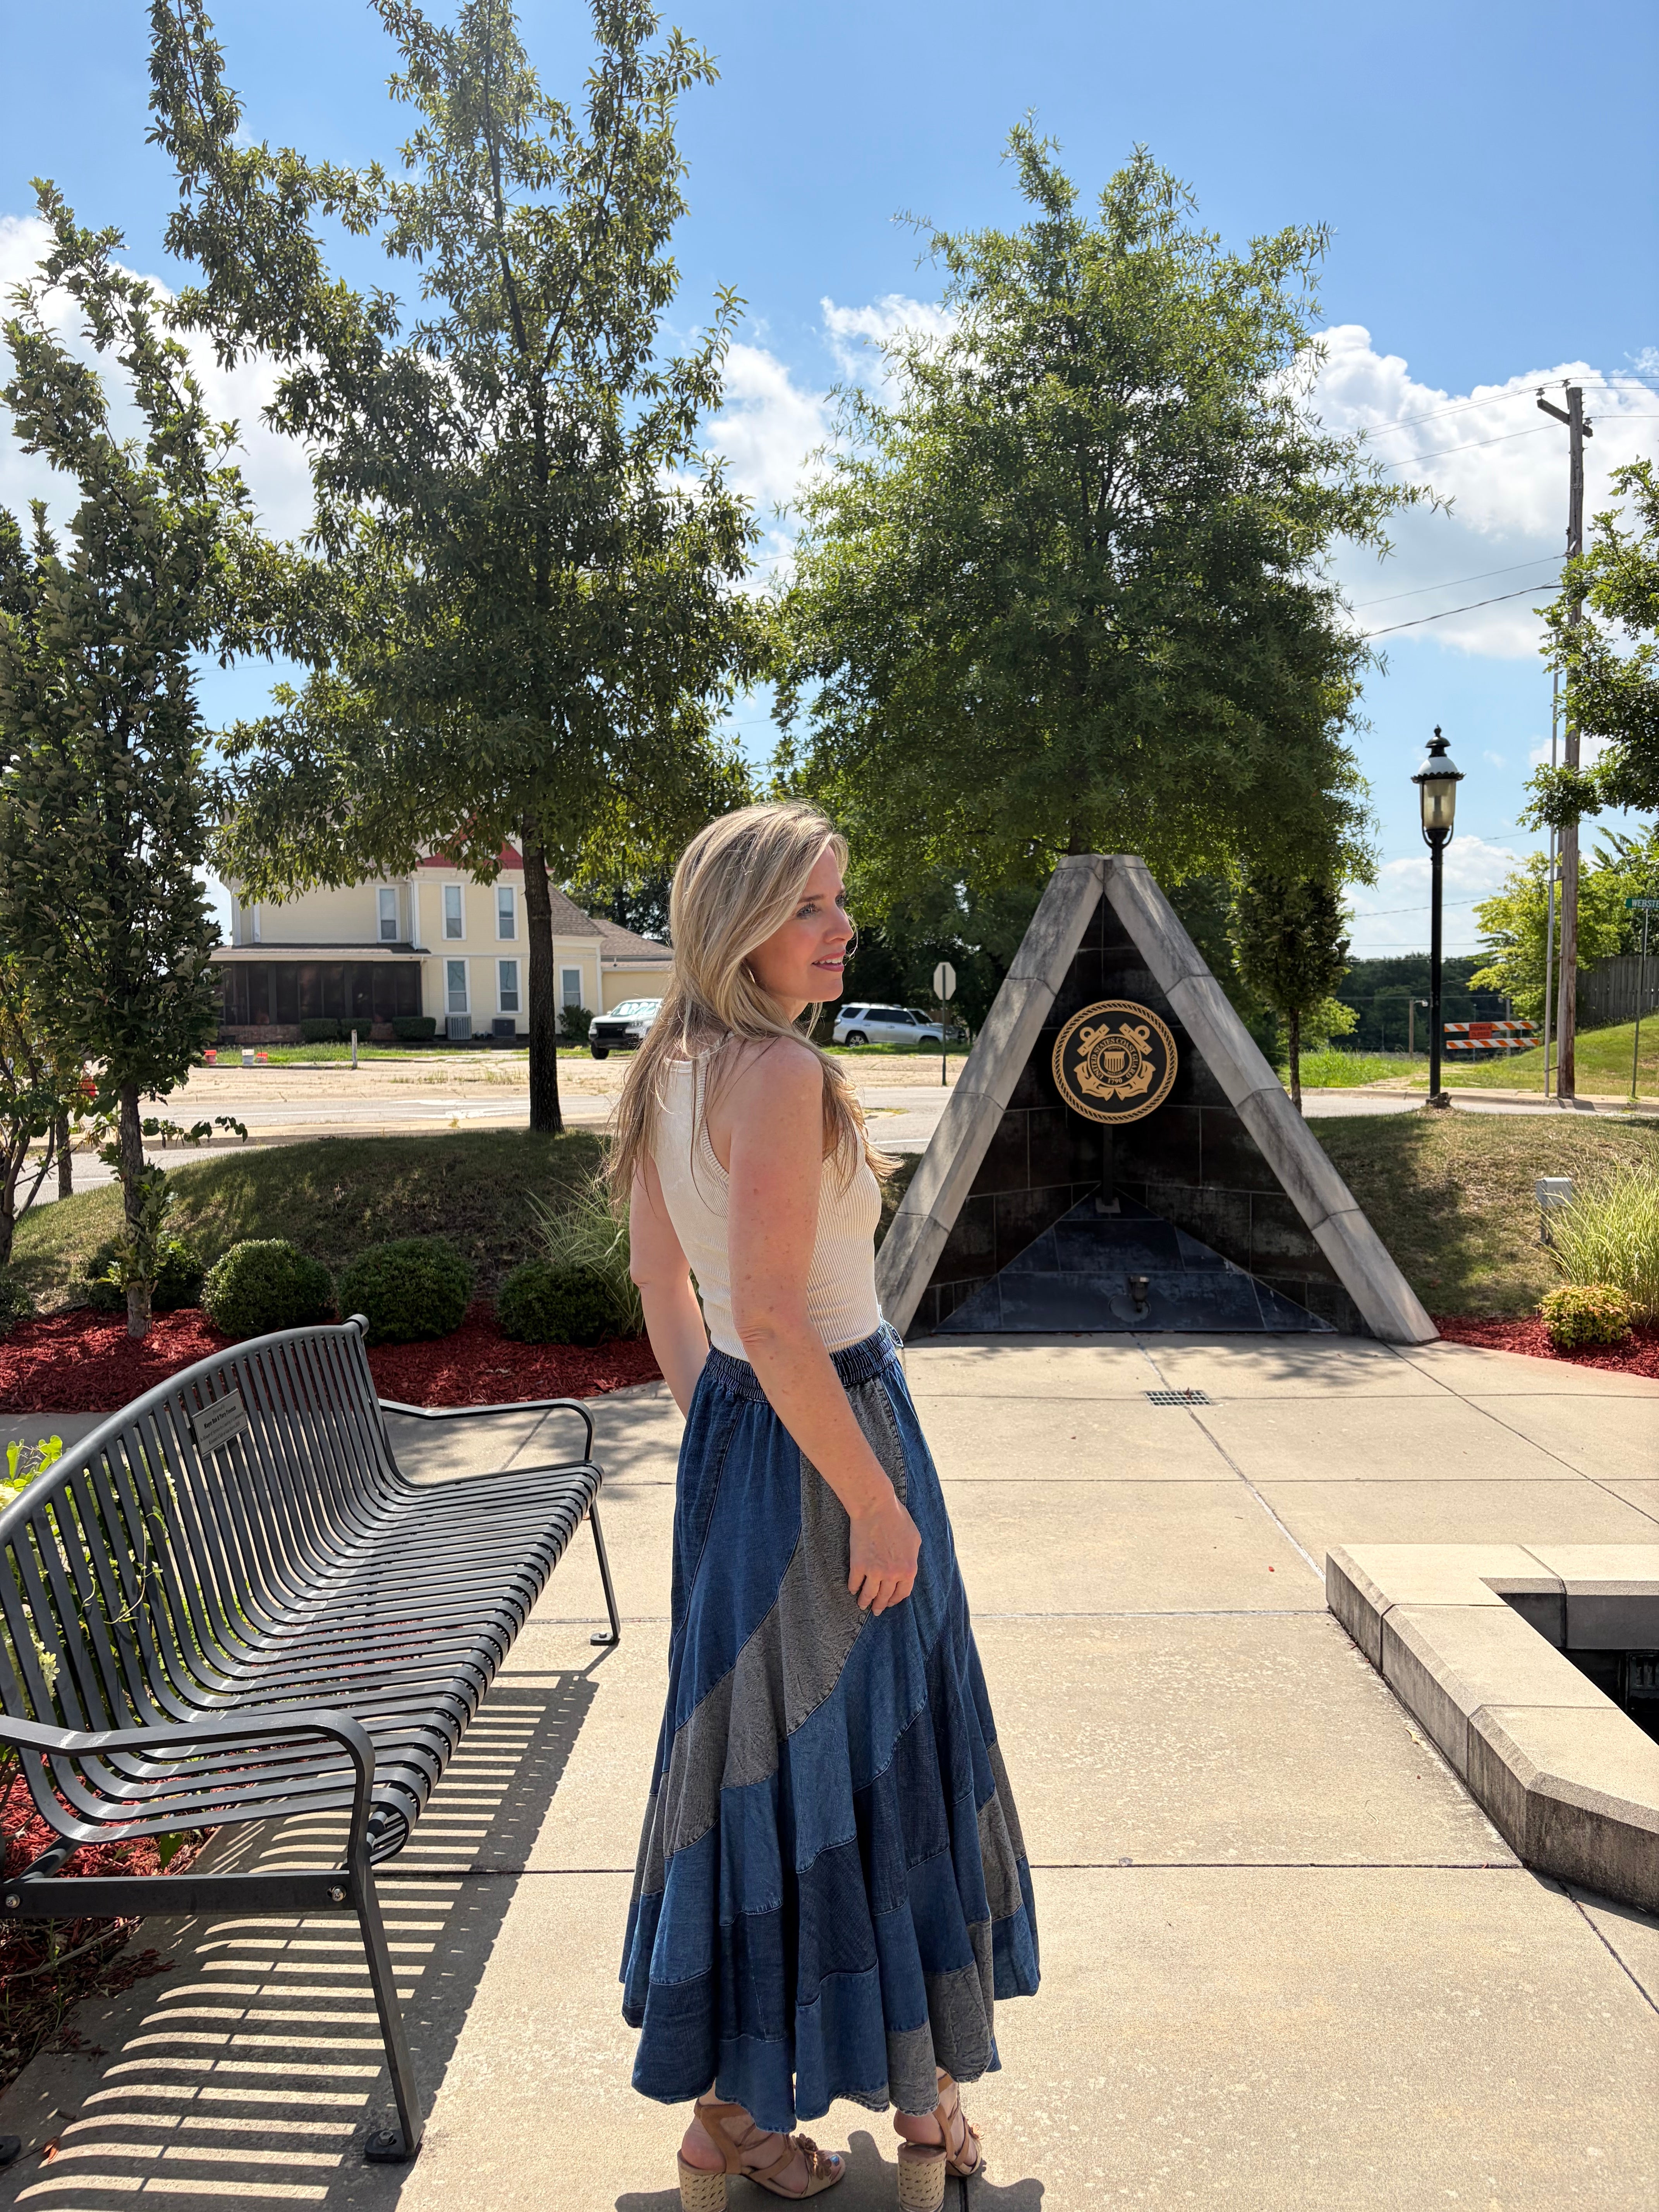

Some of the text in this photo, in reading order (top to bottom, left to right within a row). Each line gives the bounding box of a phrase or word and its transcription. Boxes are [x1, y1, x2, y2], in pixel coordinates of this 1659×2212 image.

[1091, 1038, 1138, 1079] UNITED STATES COAST GUARD
